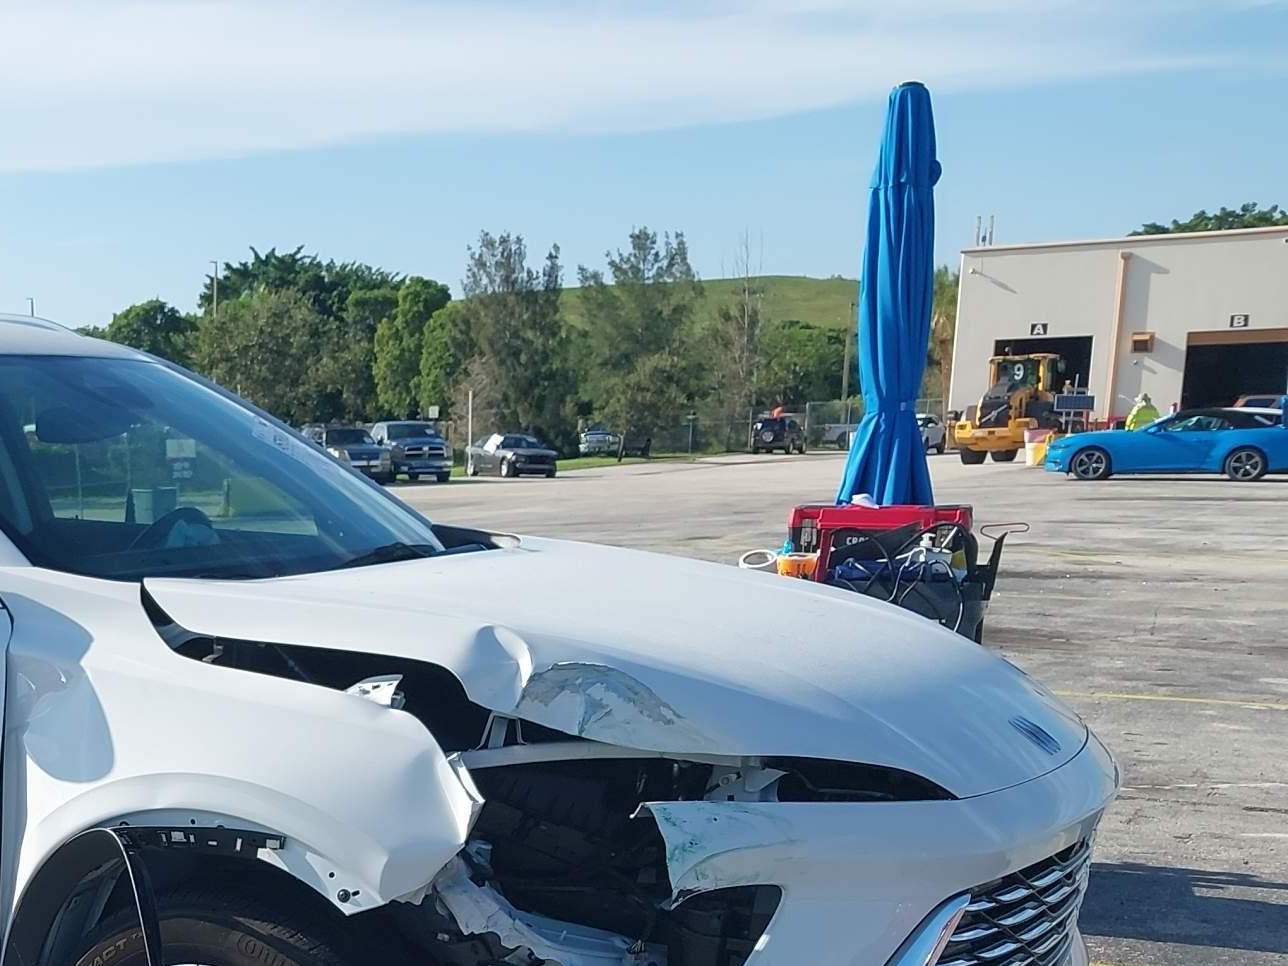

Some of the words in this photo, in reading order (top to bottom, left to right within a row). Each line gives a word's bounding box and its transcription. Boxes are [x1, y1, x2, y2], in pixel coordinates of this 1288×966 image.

[1233, 315, 1245, 327] B
[1033, 324, 1044, 335] A
[1014, 363, 1025, 380] 9
